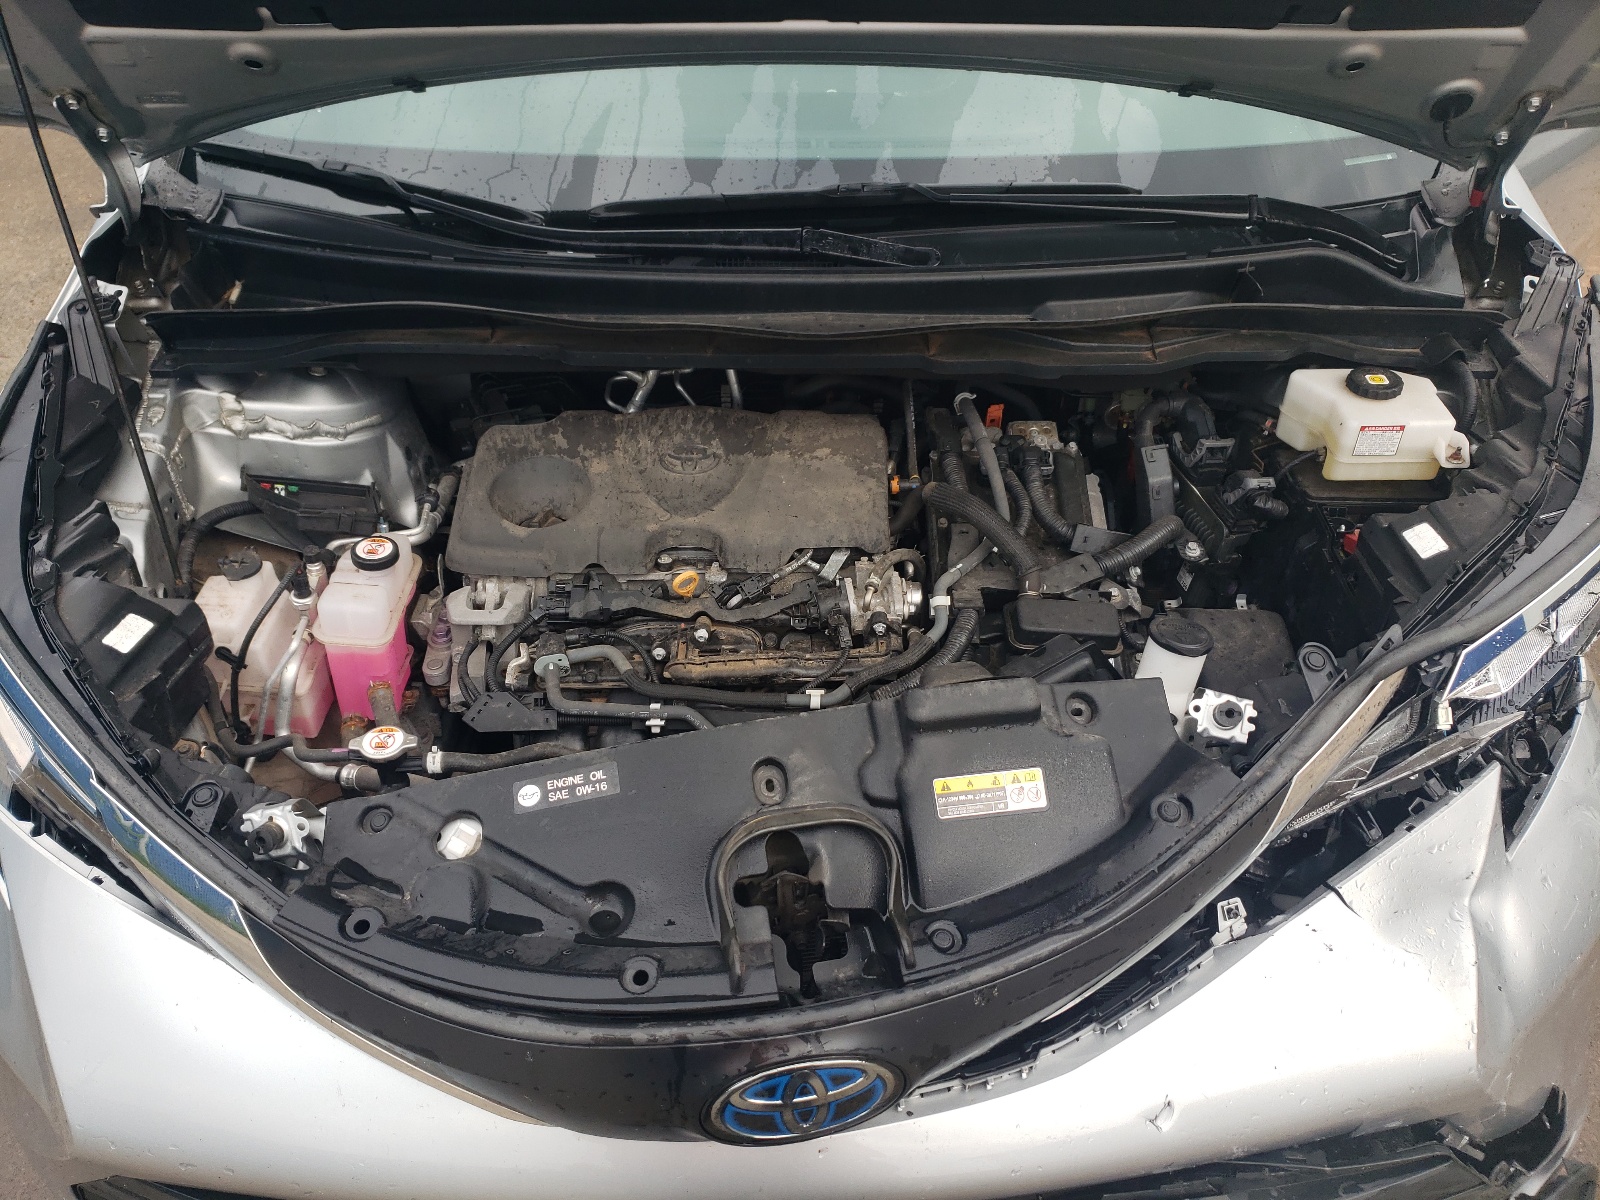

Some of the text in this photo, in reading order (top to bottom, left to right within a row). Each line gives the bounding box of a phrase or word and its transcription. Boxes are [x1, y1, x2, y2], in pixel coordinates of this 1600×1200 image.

[547, 770, 606, 789] ENGINE OIL
[548, 782, 607, 801] SAE 0W-16
